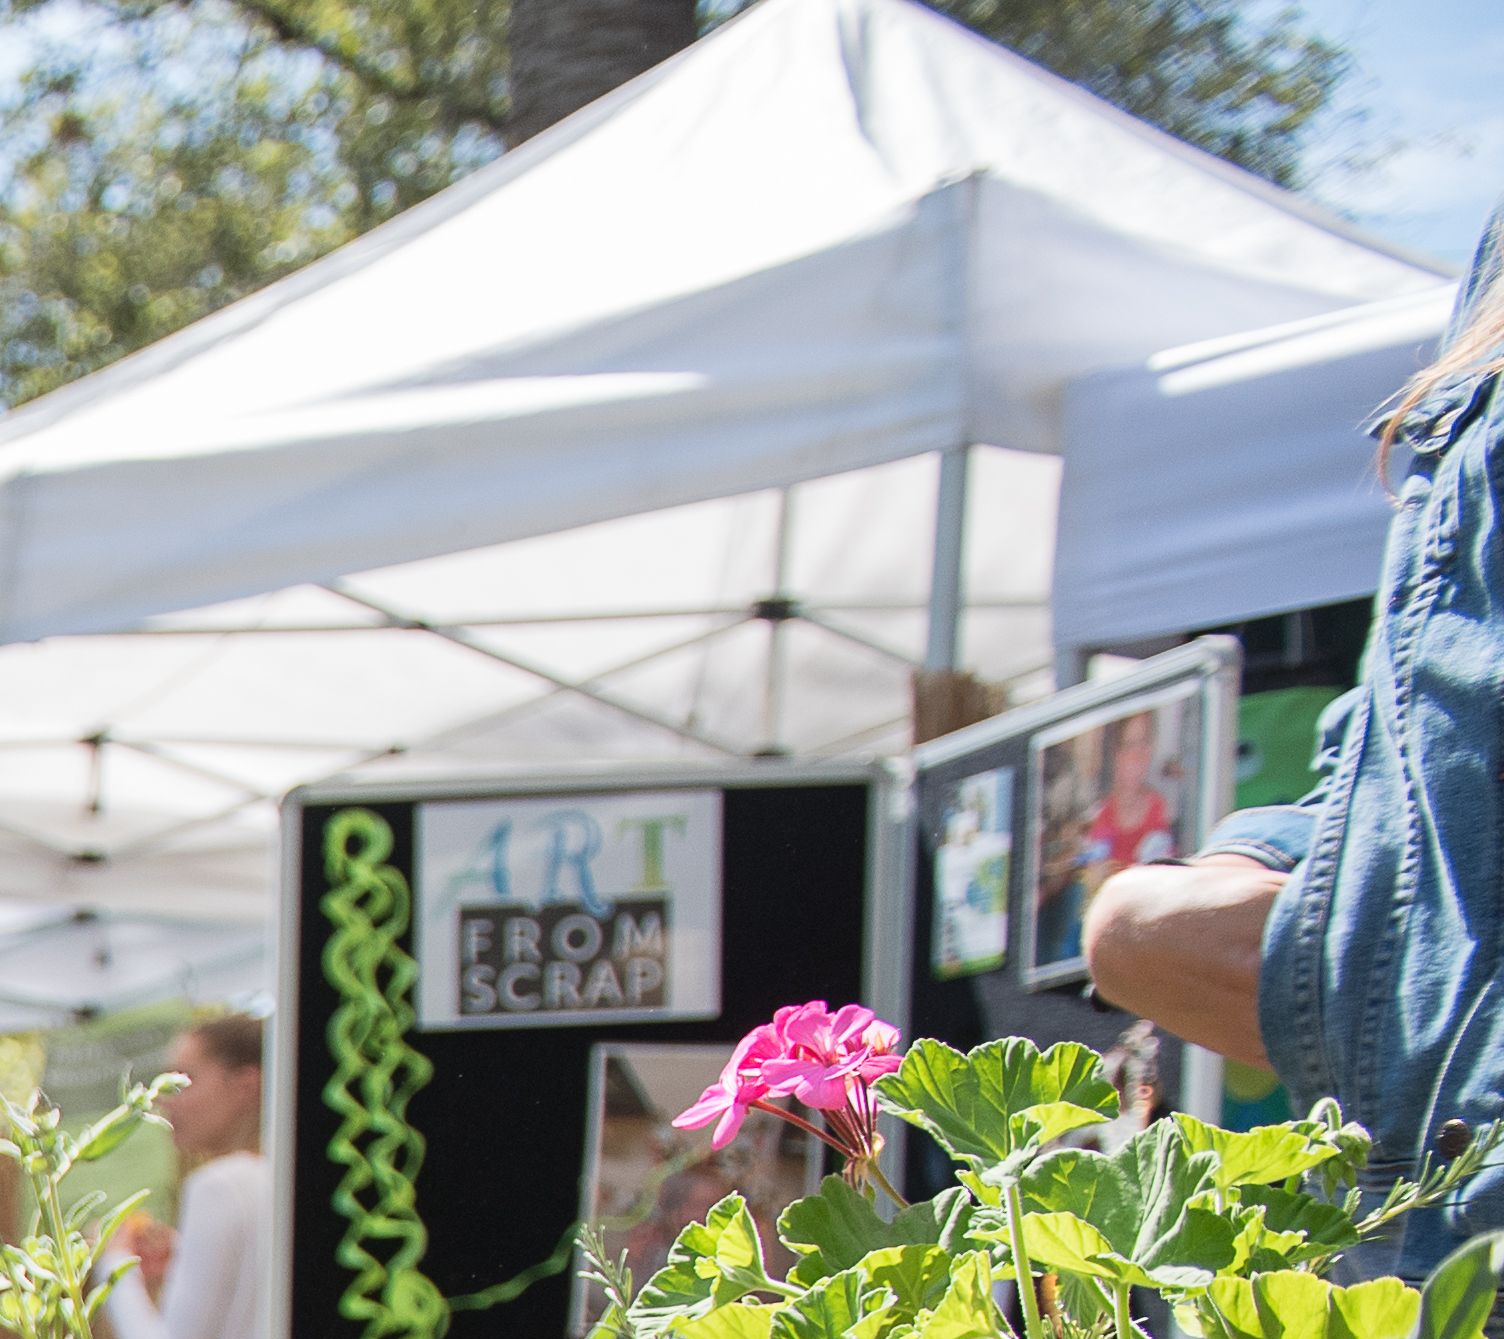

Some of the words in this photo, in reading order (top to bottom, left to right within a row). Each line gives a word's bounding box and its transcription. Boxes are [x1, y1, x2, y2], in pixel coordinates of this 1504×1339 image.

[432, 811, 686, 920] ART
[463, 912, 662, 963] FROM
[463, 957, 663, 1013] SCRAP
